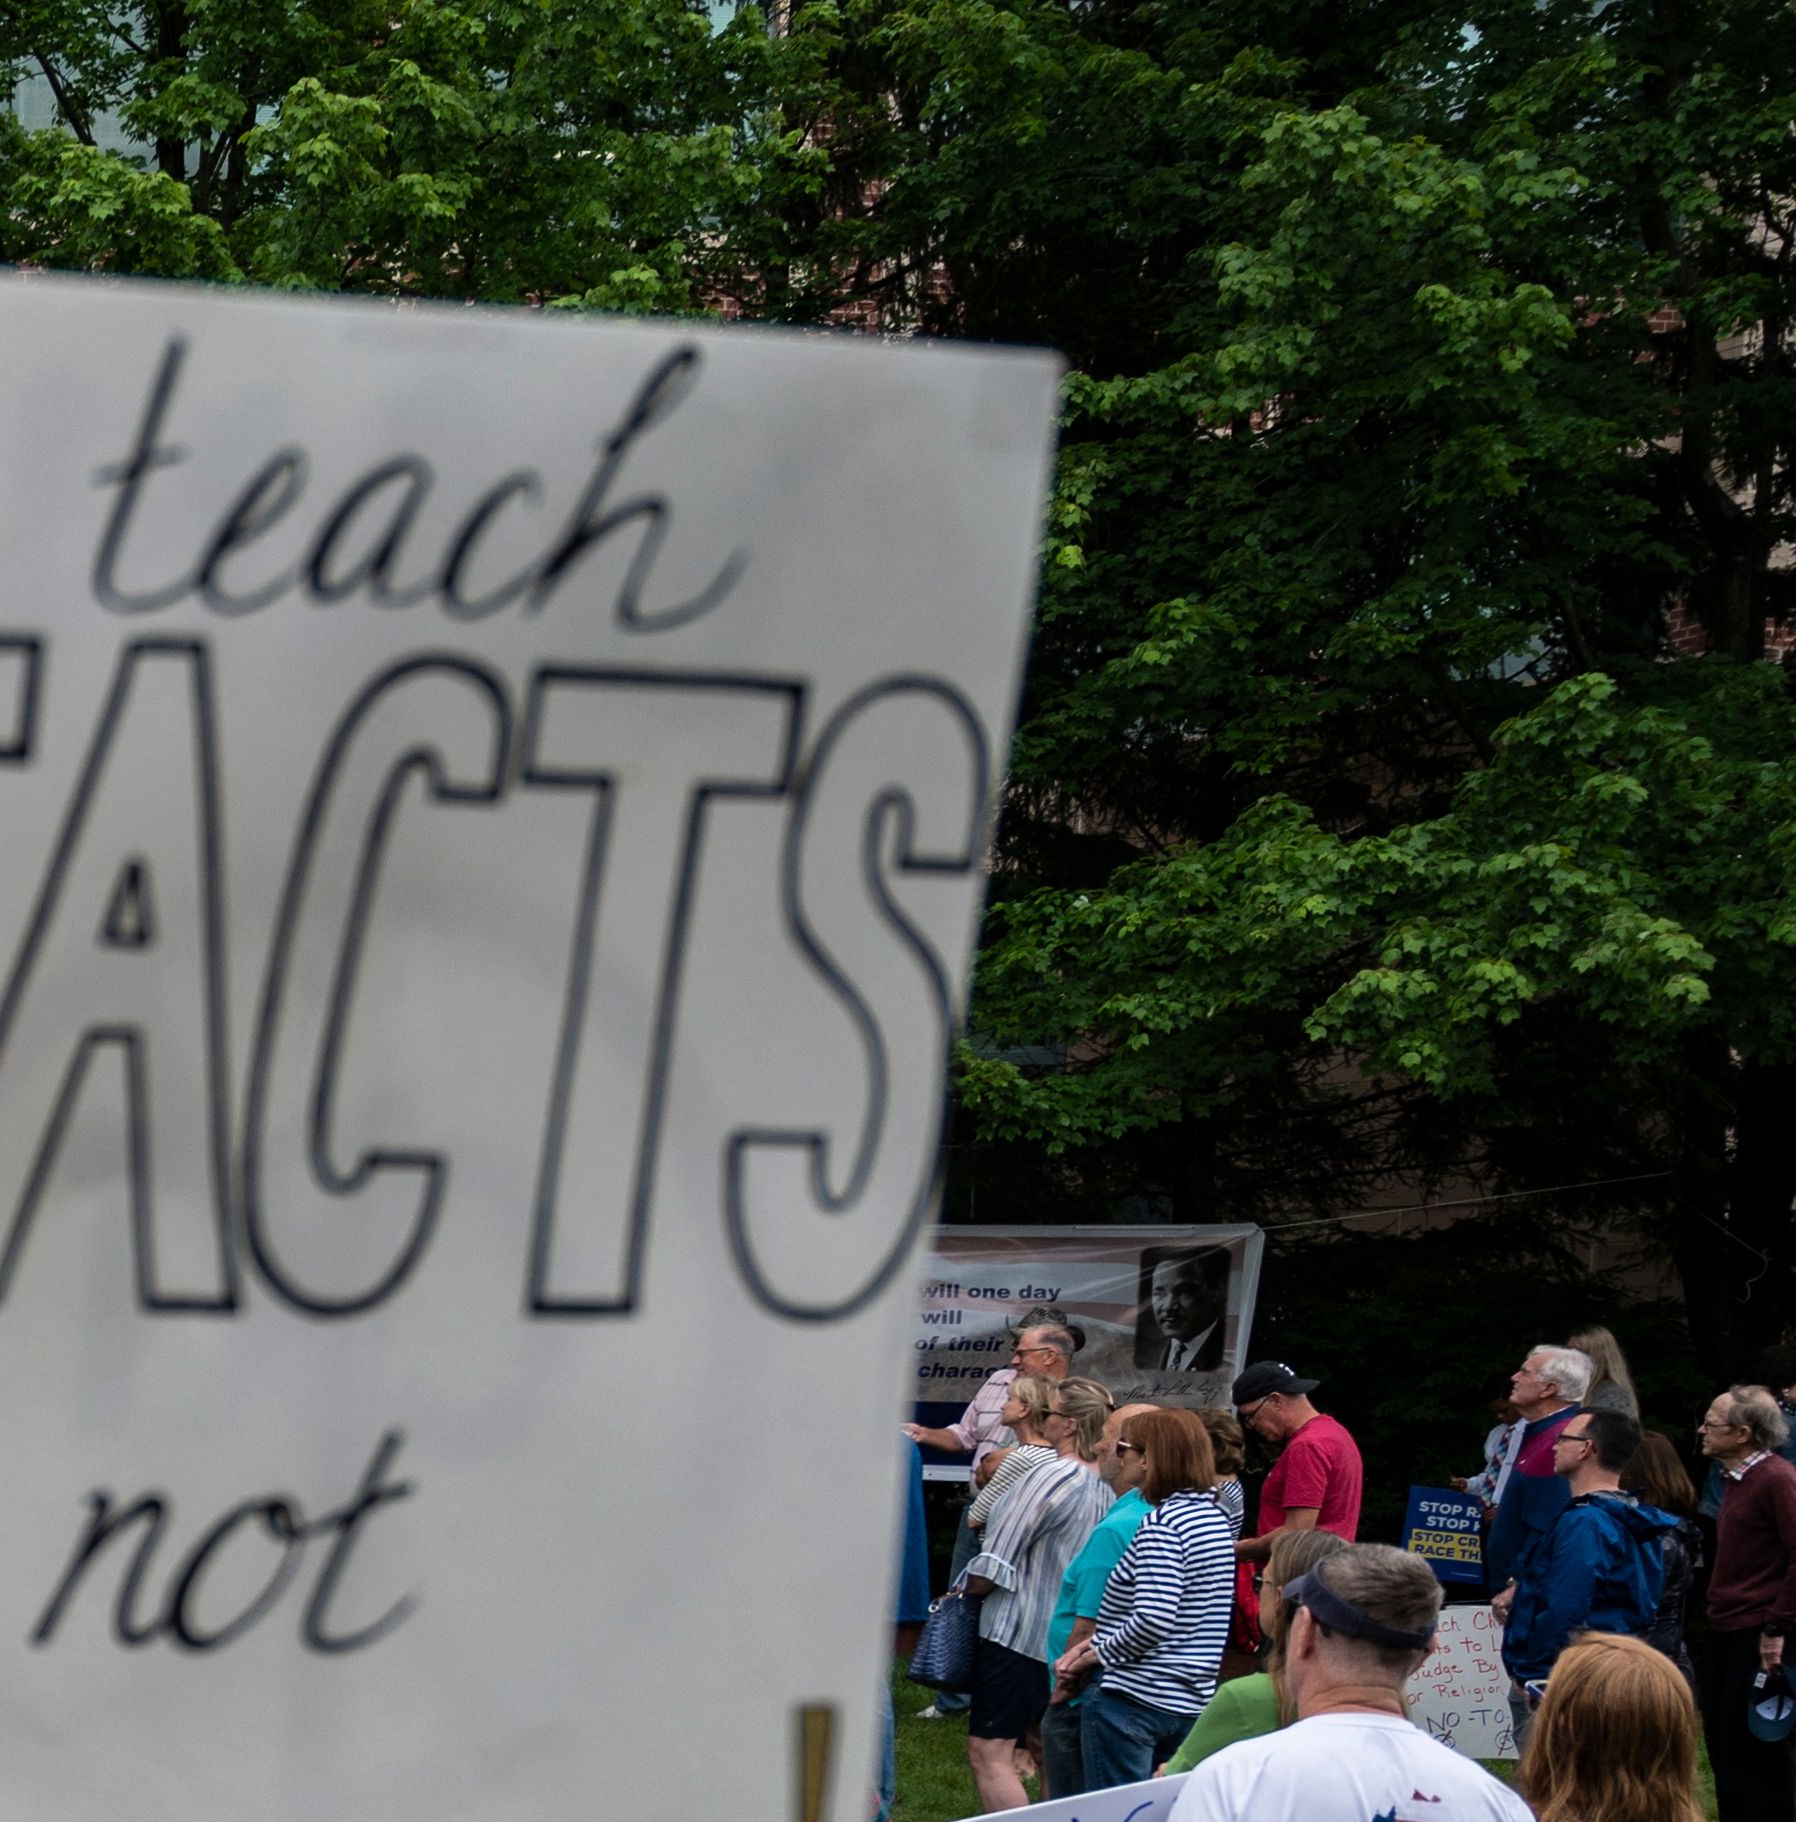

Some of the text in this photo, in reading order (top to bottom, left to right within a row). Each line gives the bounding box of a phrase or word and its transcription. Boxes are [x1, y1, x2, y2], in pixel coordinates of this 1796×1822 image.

[88, 330, 751, 634] teach
[967, 1287, 1011, 1299] one
[1018, 1284, 1061, 1302] day
[921, 1310, 963, 1325] will
[915, 1336, 939, 1351] of
[947, 1336, 1005, 1352] their
[1419, 1500, 1463, 1515] STOP
[1426, 1515, 1470, 1530] STOP
[27, 1428, 417, 1654] not
[1414, 1531, 1454, 1544] STOP
[1414, 1544, 1455, 1557] RACE
[1460, 1636, 1482, 1653] to
[1472, 1658, 1500, 1681] By
[1432, 1683, 1505, 1703] Religion
[1426, 1711, 1461, 1733] NO
